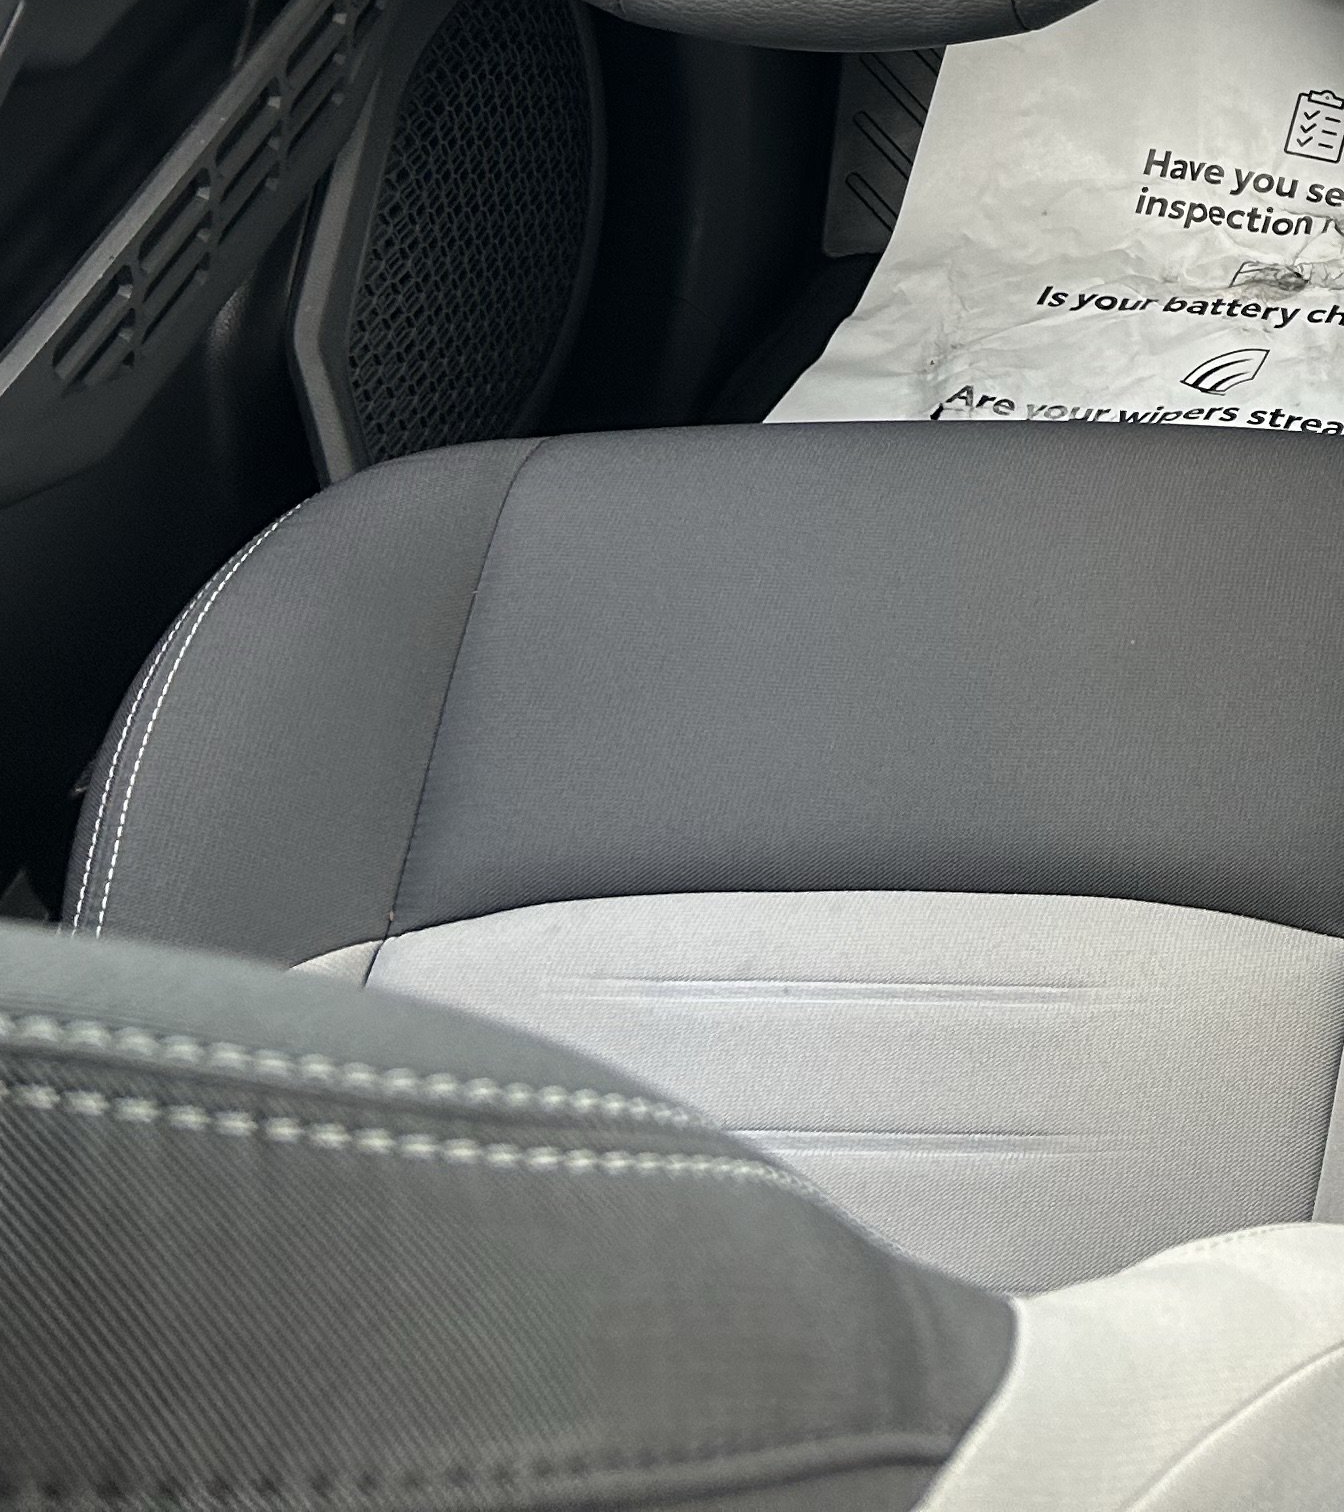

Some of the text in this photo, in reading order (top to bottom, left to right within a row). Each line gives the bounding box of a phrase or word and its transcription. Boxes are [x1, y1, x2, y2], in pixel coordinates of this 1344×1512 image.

[1143, 149, 1224, 184] Have
[1230, 169, 1298, 199] you
[1135, 187, 1312, 236] inspection
[1036, 286, 1068, 307] Is
[1069, 291, 1161, 311] your
[1163, 295, 1301, 329] battery
[945, 385, 1016, 416] Are
[1117, 402, 1240, 426] wipers
